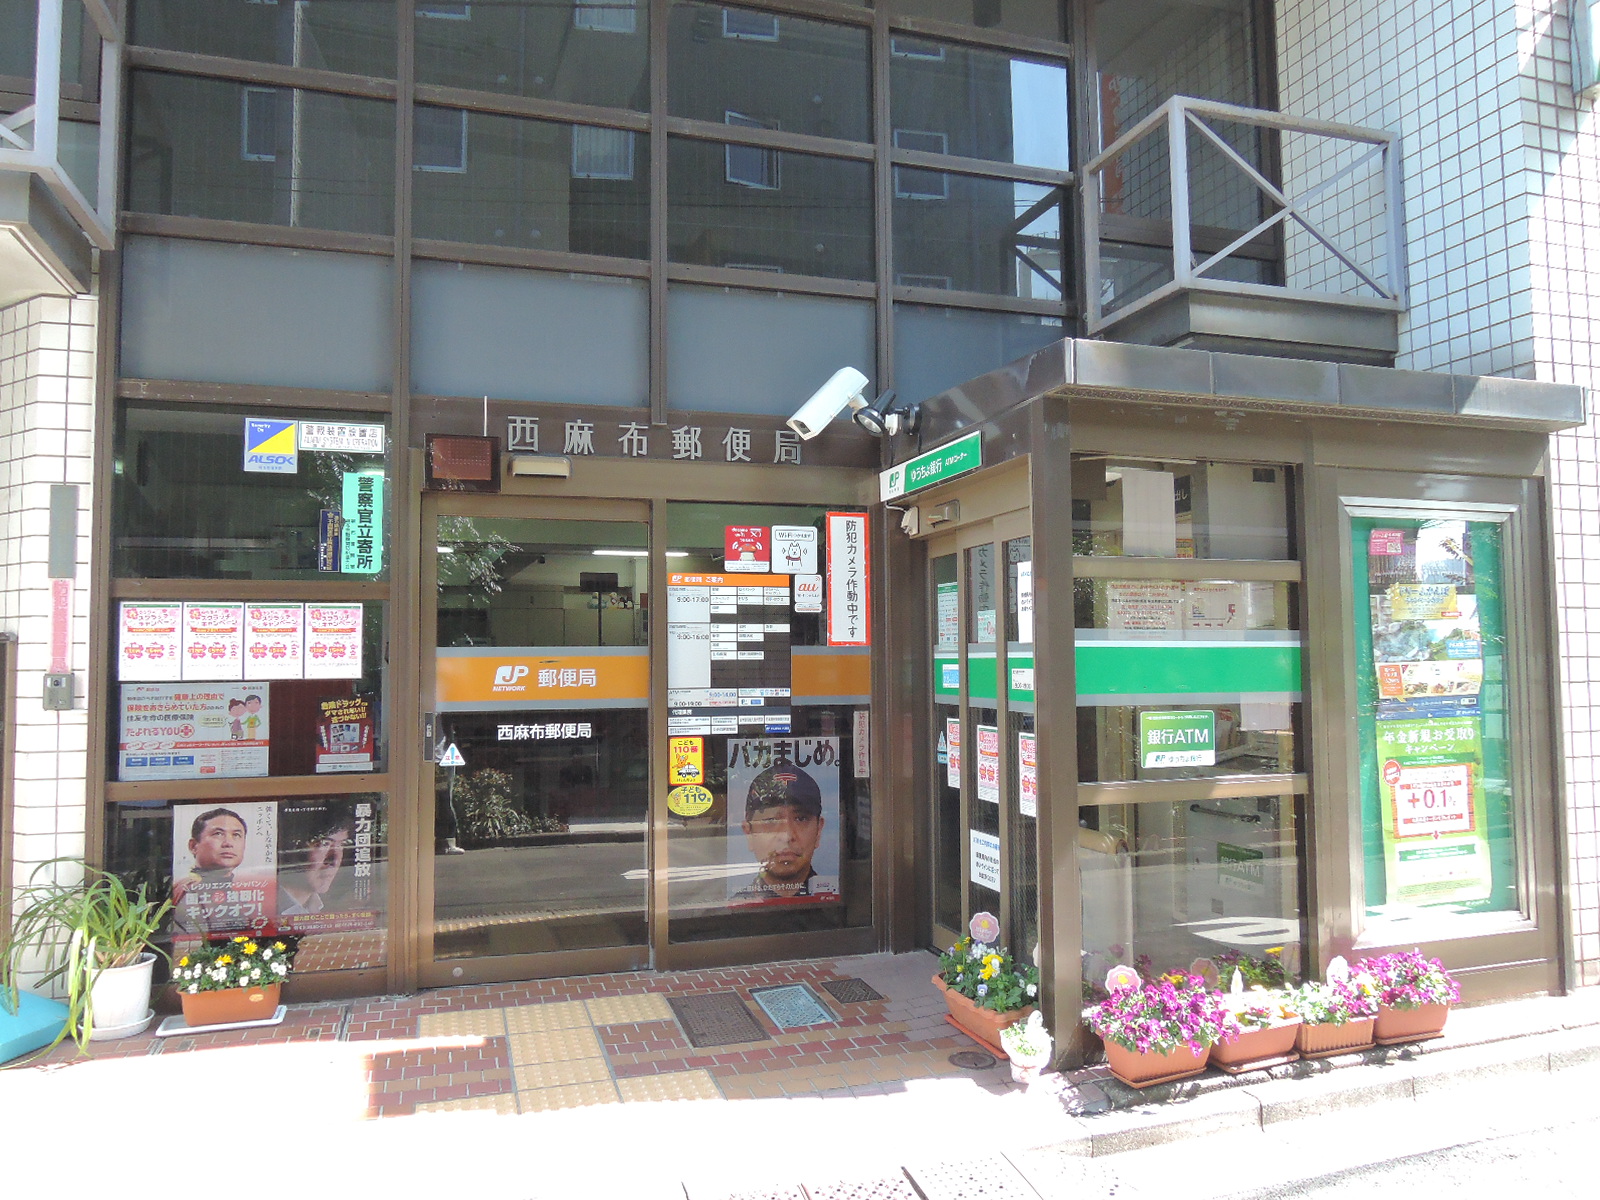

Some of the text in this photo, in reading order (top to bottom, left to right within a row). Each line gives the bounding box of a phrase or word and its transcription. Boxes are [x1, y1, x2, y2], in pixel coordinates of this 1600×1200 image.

[507, 415, 801, 465] 西麻布郵便局
[248, 455, 294, 465] ALSOK
[911, 458, 942, 482] ゆうちょ銀行
[357, 477, 374, 570] 警察官立寄所
[845, 520, 859, 638] 防犯カメラ作動中です
[494, 665, 529, 685] JP
[538, 668, 597, 688] 郵便局
[497, 723, 592, 741] 西麻布郵便局
[1147, 728, 1209, 745] 銀行ATM
[1383, 727, 1475, 744] 年金新規お受取り
[728, 739, 840, 769] バカまじめ。
[1405, 744, 1455, 754] キャンペーン
[354, 803, 372, 877] 暴力団追放
[186, 903, 263, 919] キックオフ!
